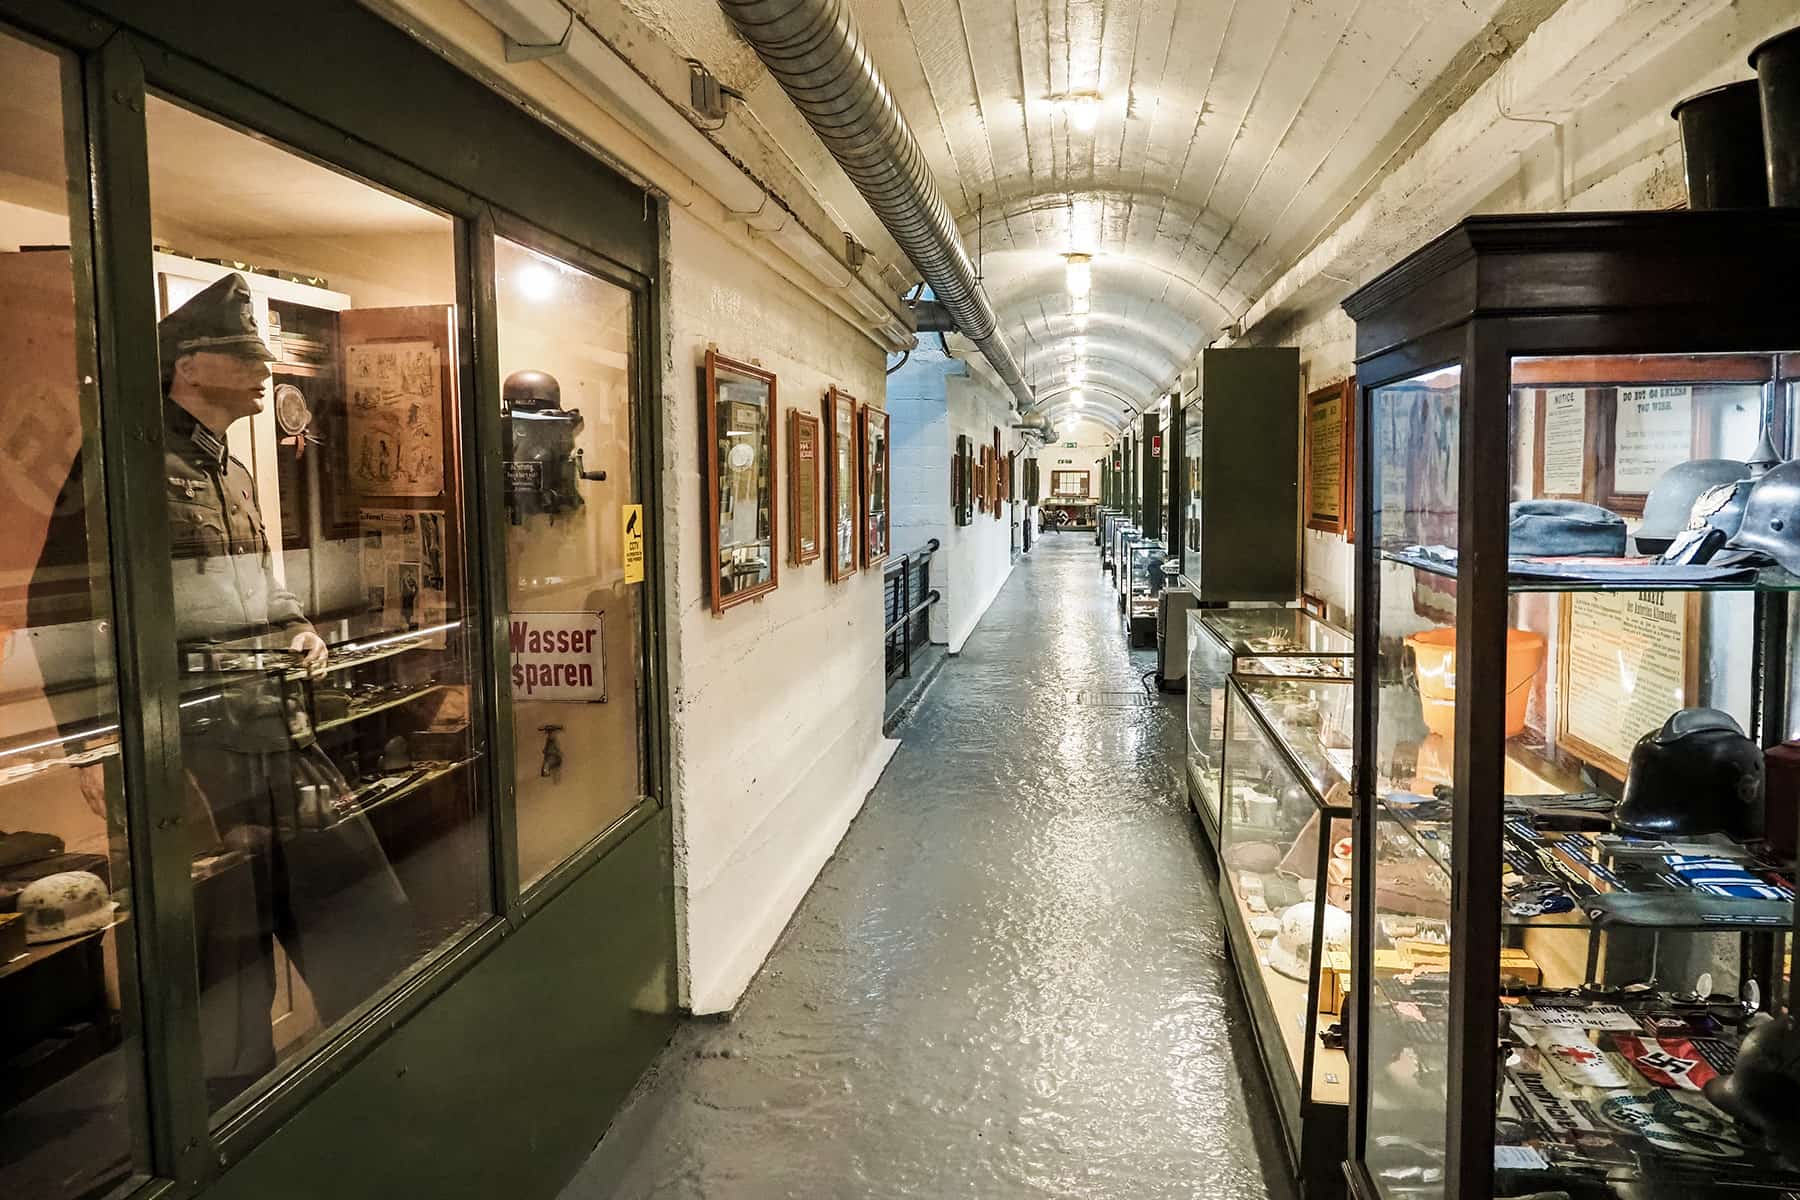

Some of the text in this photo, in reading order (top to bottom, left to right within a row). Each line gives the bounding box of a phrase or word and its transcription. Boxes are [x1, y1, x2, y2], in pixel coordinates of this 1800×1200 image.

[1554, 391, 1575, 404] NOTICE
[1623, 391, 1633, 402] DO
[1634, 390, 1646, 401] NOT
[509, 621, 597, 653] Wasser
[512, 662, 593, 694] sparen
